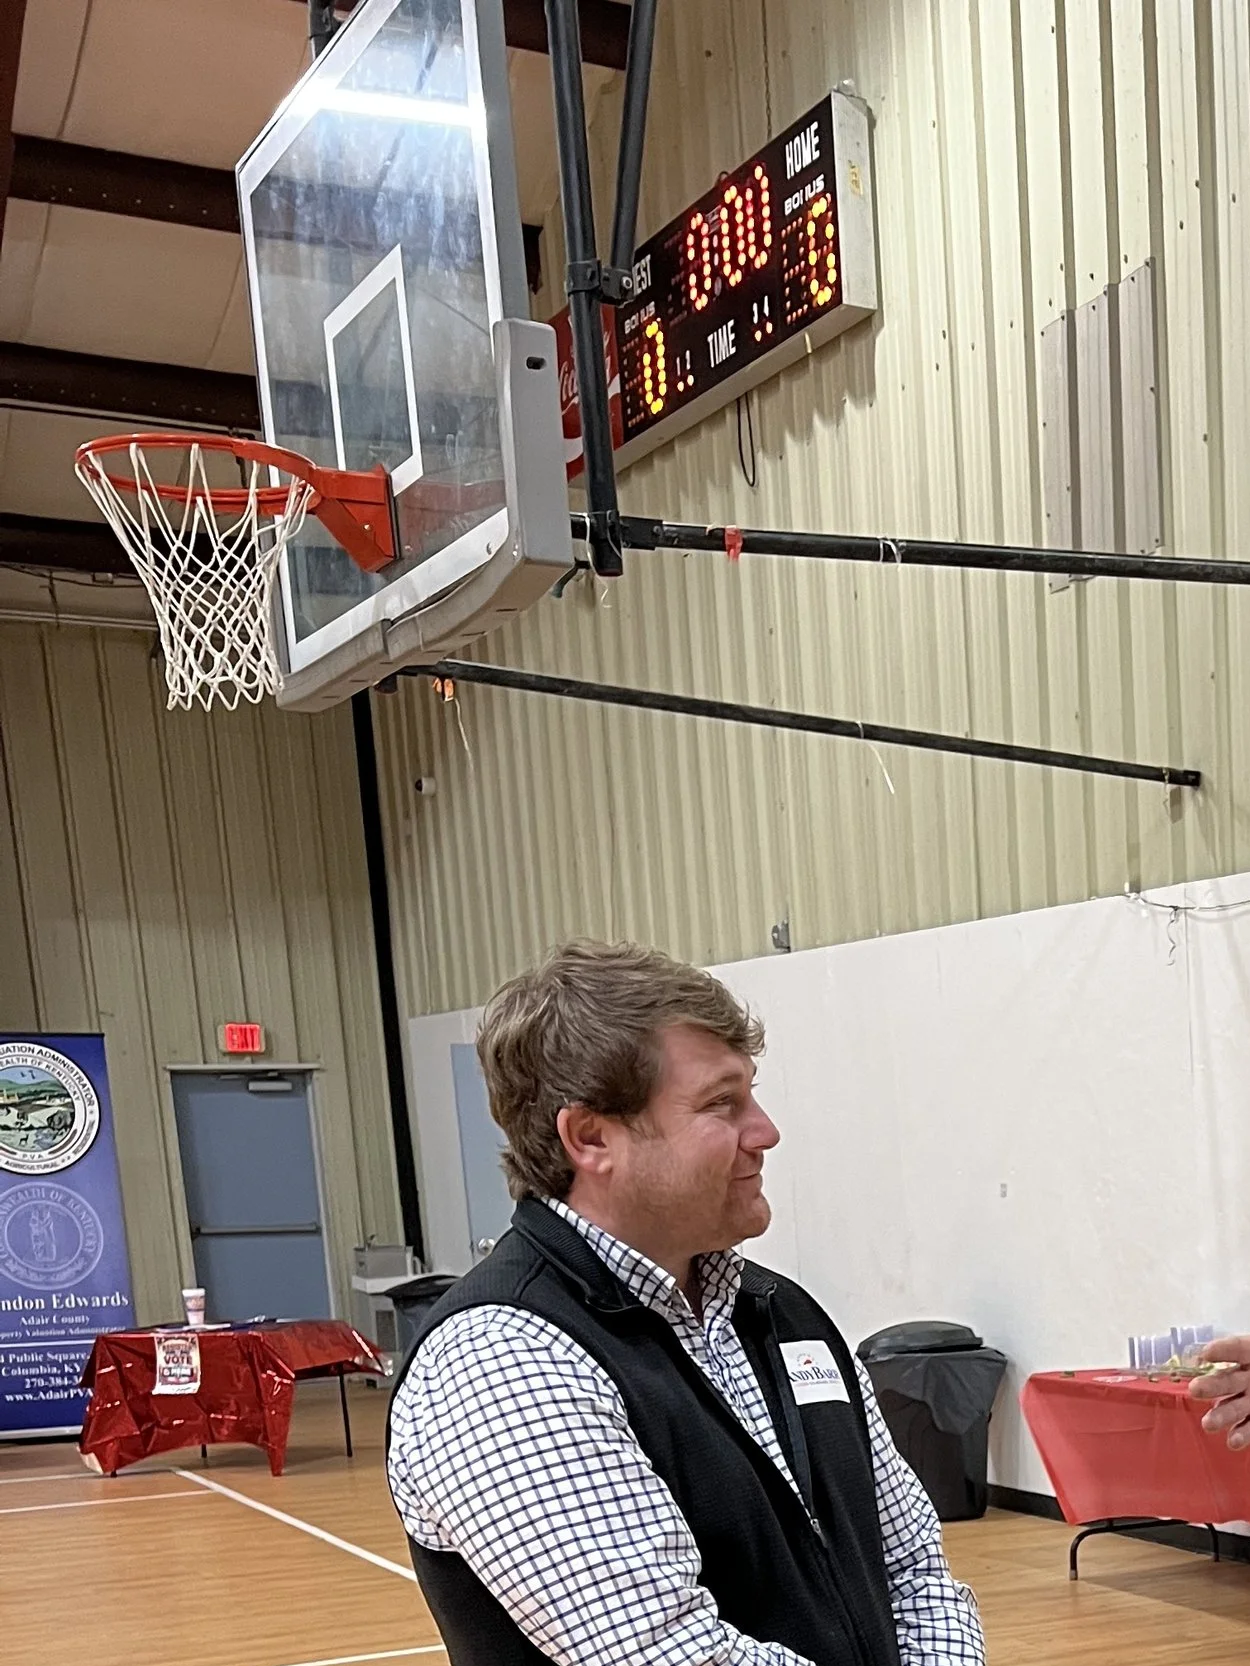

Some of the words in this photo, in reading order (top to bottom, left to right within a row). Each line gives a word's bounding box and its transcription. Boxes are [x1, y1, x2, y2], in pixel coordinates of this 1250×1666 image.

[785, 121, 820, 180] HOME
[784, 173, 825, 216] BONUS
[632, 254, 652, 296] EST
[706, 319, 737, 368] TIME
[227, 1026, 259, 1050] EXIT
[37, 1049, 95, 1107] ADMINISTRATOR
[52, 1291, 129, 1309] Edwards
[20, 1315, 50, 1326] Adair
[52, 1314, 90, 1325] County
[8, 1352, 43, 1363] Public
[163, 1356, 193, 1365] VOTE
[1, 1364, 61, 1377] Columbia,
[64, 1362, 81, 1373] KY
[25, 1376, 80, 1388] 270-384-3
